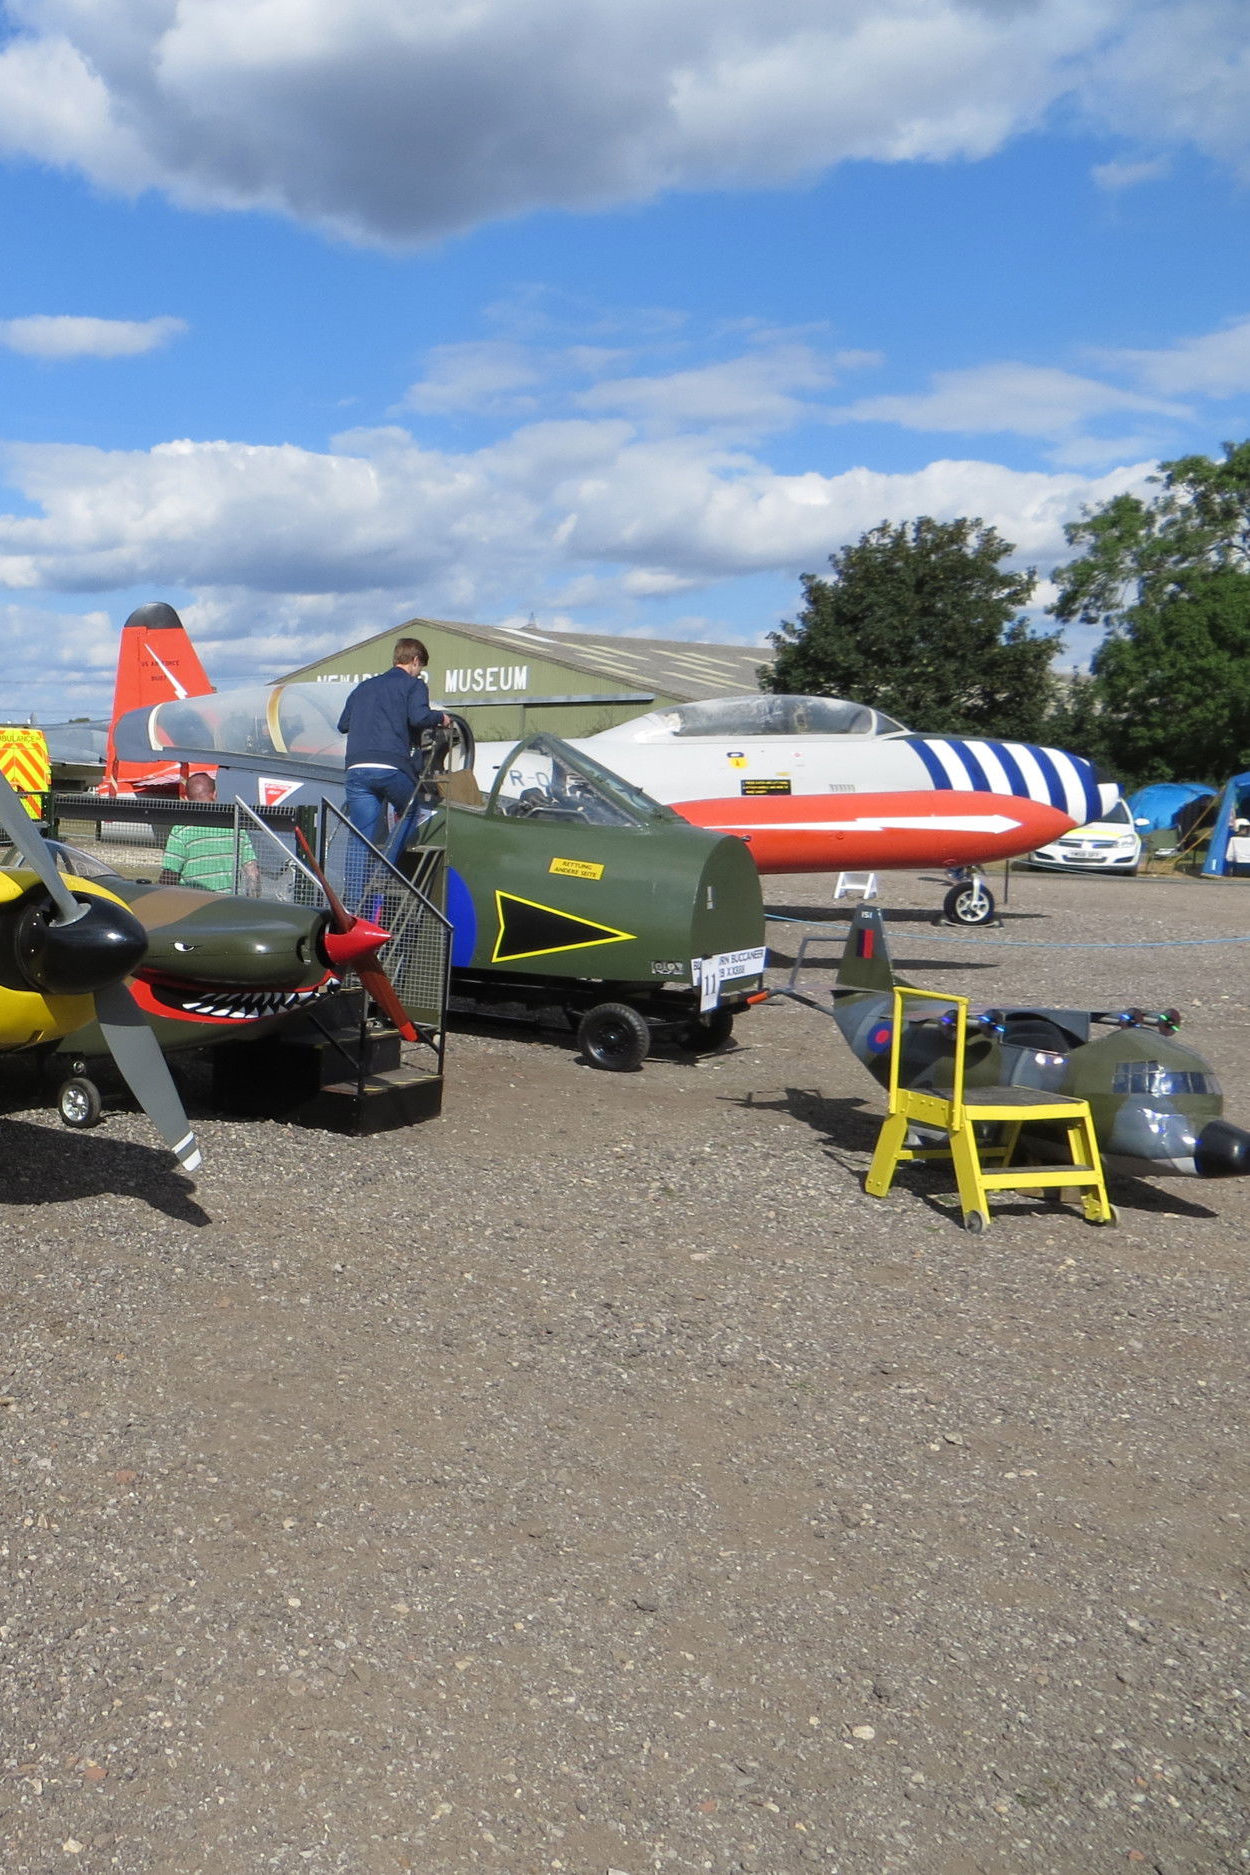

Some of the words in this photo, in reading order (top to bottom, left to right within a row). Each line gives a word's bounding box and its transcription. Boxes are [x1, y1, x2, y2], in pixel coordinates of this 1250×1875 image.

[445, 665, 528, 693] MUSEUM
[562, 860, 593, 870] RETTUNG
[730, 949, 765, 964] BUCCANEER
[704, 973, 717, 996] 11
